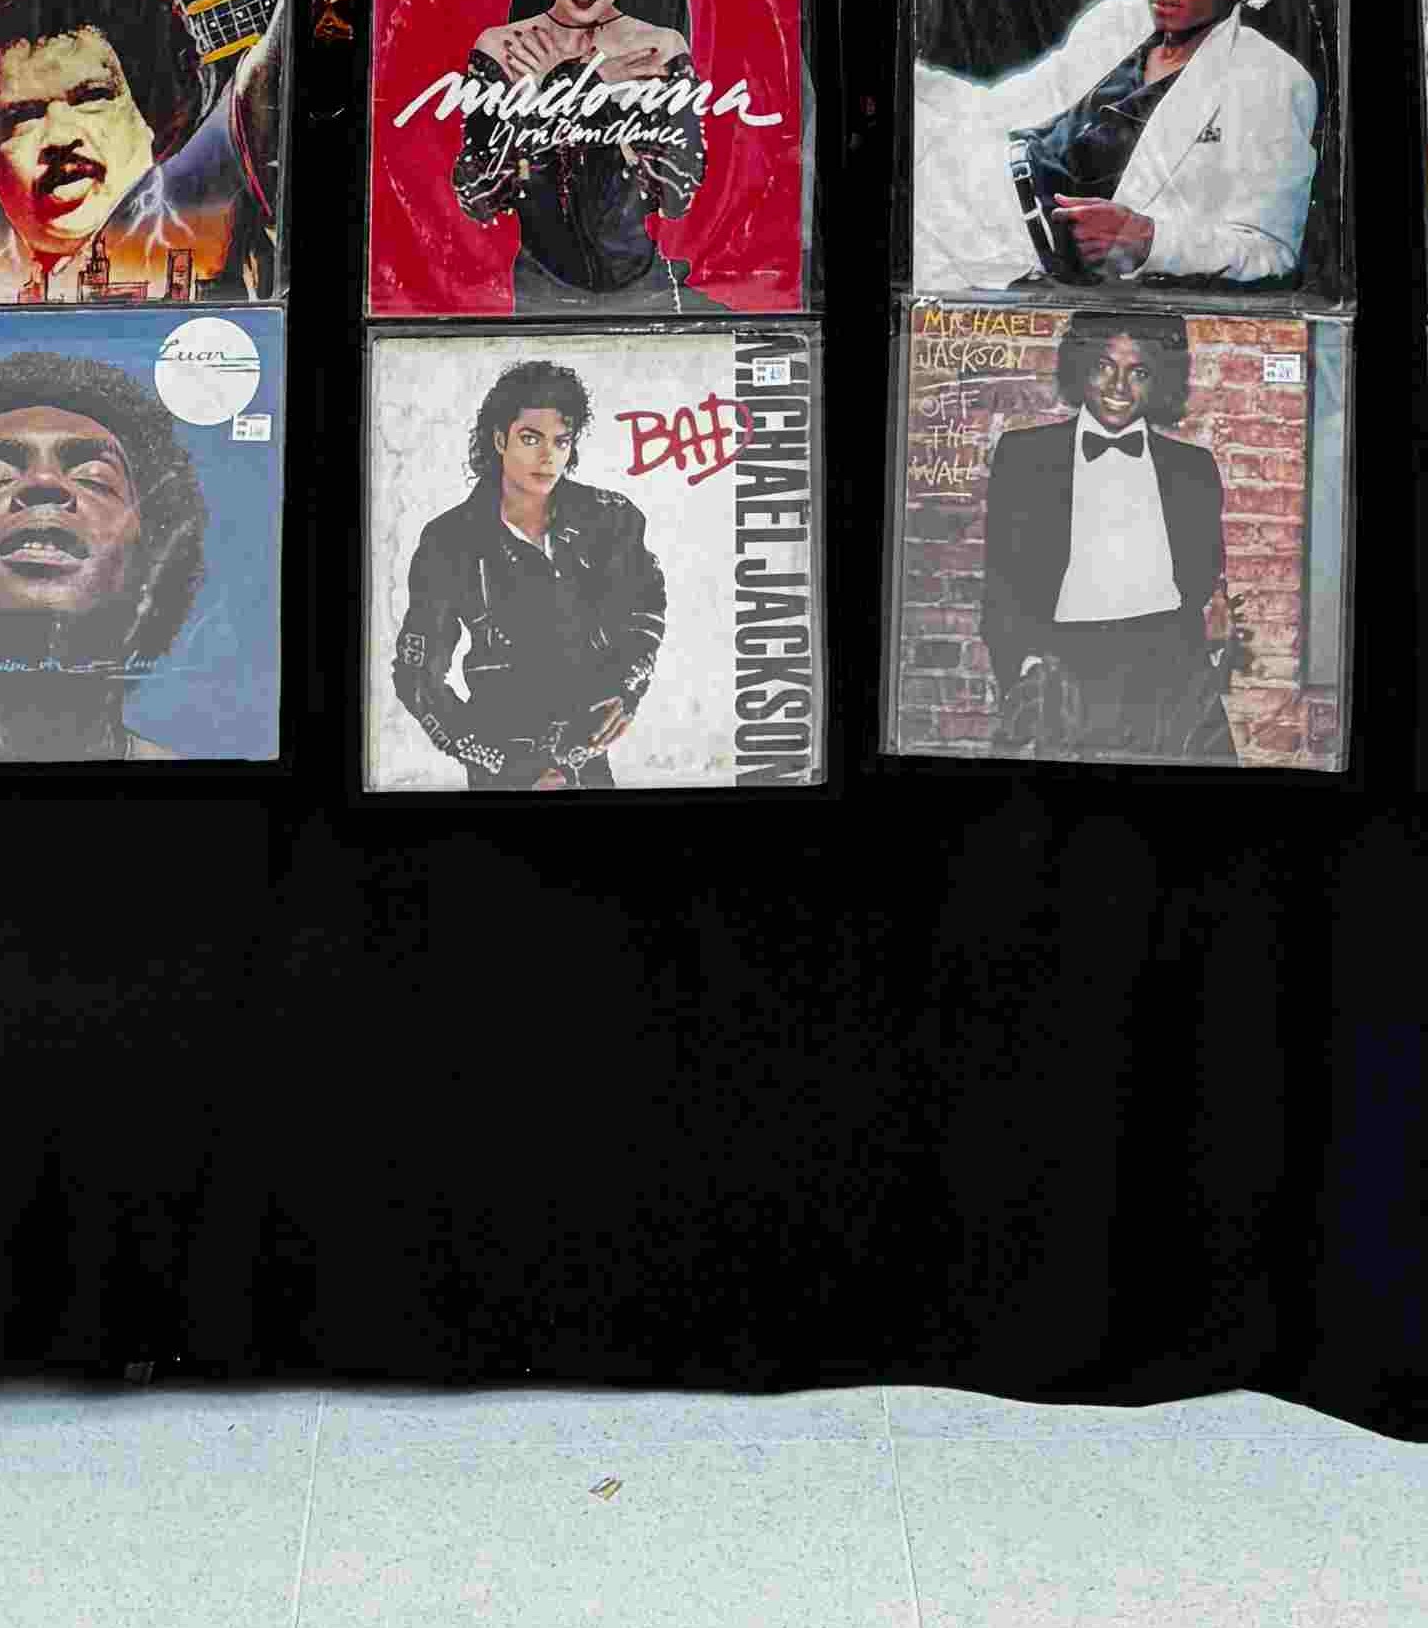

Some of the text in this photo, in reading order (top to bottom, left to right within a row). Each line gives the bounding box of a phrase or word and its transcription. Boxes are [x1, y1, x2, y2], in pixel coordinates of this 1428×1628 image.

[922, 308, 1051, 337] MICHAEL
[918, 343, 1028, 373] JACKSON
[922, 388, 981, 421] OFF
[614, 392, 756, 486] BAD
[735, 332, 811, 556] MICHAEL
[735, 558, 812, 785] JACKSON
